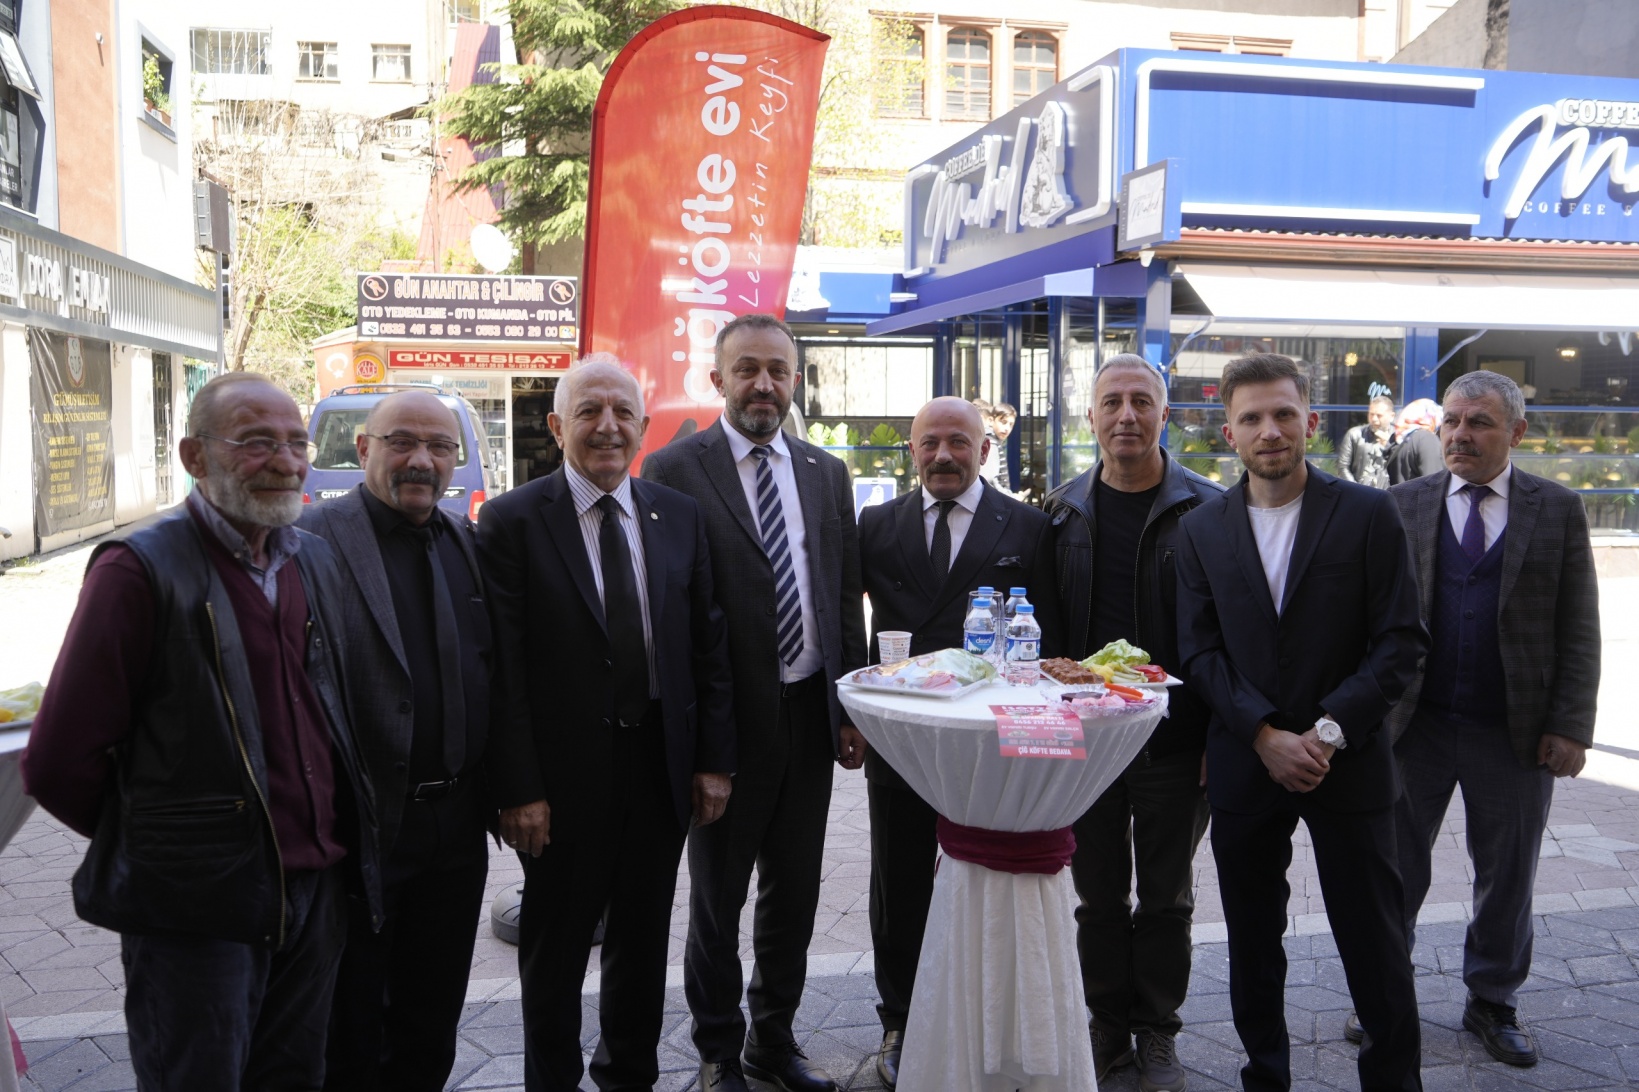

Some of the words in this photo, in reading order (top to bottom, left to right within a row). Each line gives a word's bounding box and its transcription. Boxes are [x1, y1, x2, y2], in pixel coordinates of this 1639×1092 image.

[695, 51, 747, 136] evi
[749, 56, 794, 142] Keyfi
[945, 147, 974, 181] COFFEE
[1524, 201, 1606, 216] COFFEE
[739, 162, 768, 308] Lezzetin
[25, 251, 63, 302] DORA
[394, 276, 420, 298] GÜN
[422, 279, 479, 300] ANAHTAR
[481, 281, 490, 300] &
[492, 278, 544, 304] ÇİLİNGİR
[362, 306, 383, 318] OTO
[384, 306, 447, 319] YEDEKLEME
[455, 308, 476, 319] OTO
[477, 308, 529, 320] KUMANDA
[536, 309, 557, 321] OTO
[558, 308, 575, 321] PİL
[396, 352, 451, 362] GÜN
[460, 353, 562, 364] TESİSAT
[1030, 747, 1048, 755] KÖFTE
[1049, 748, 1072, 756] BEDAVA
